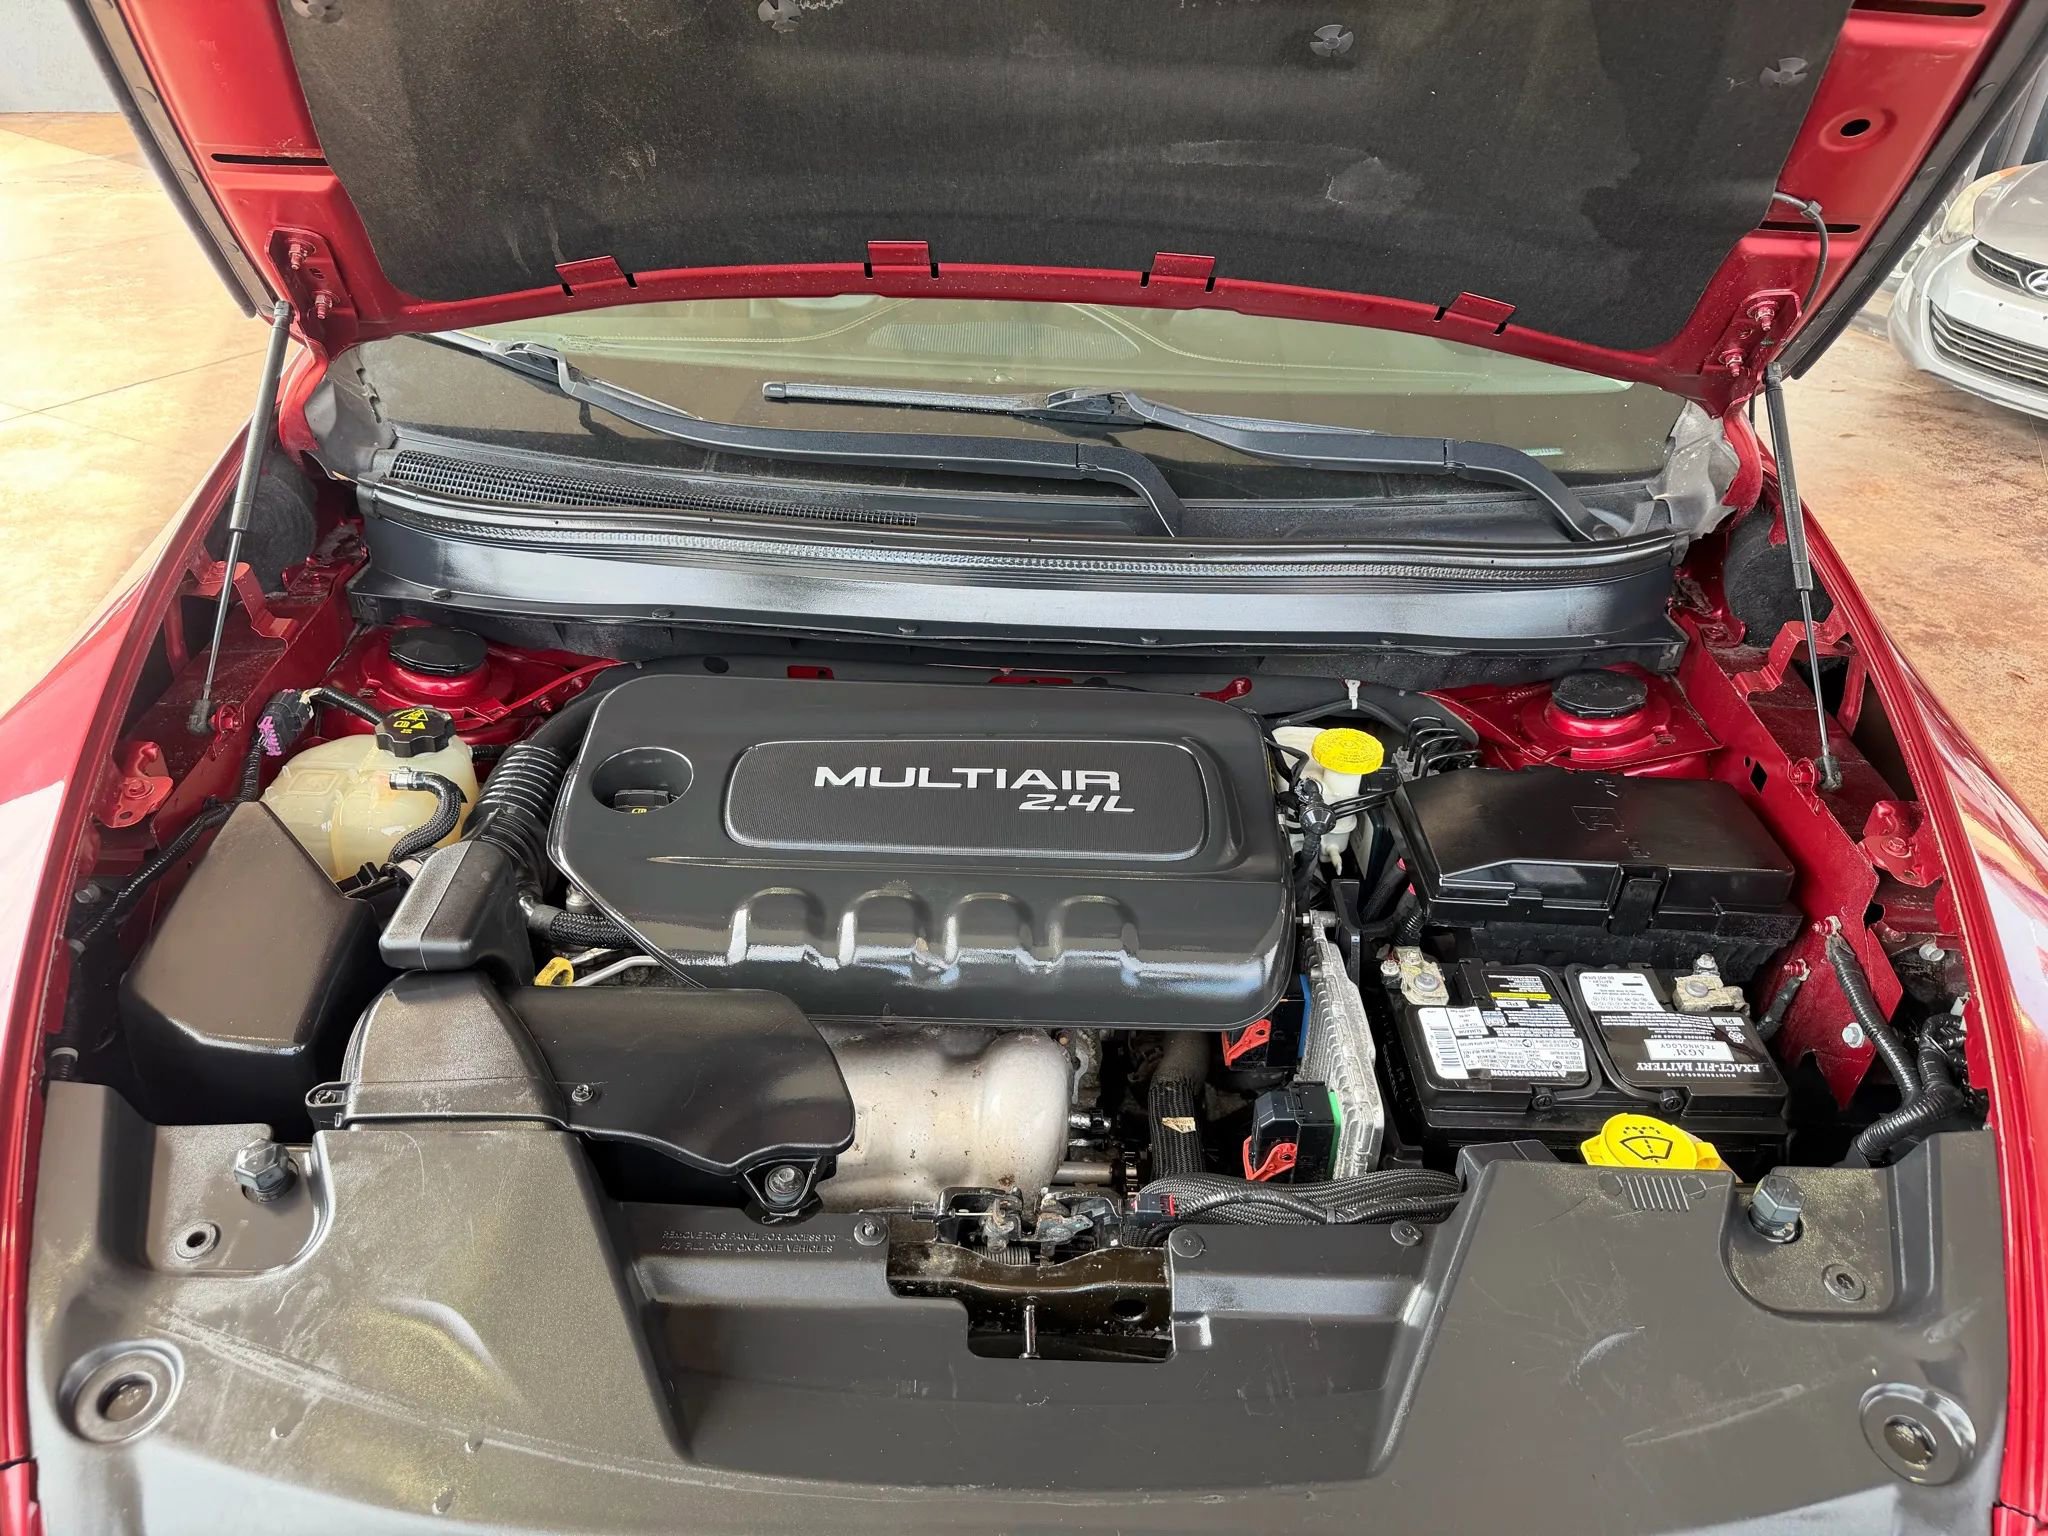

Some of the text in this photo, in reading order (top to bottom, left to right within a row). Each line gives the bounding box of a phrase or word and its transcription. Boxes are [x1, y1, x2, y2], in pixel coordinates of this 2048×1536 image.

[814, 766, 1120, 791] MULTIAIR
[1018, 794, 1135, 813] 2.4L
[1636, 1062, 1760, 1073] EXACT-FIT BATTERY
[662, 1230, 836, 1242] REMOVE THIS PANEL FOR ACCESS TO
[754, 1243, 783, 1252] SOME
[786, 1244, 833, 1253] VEHICLES
